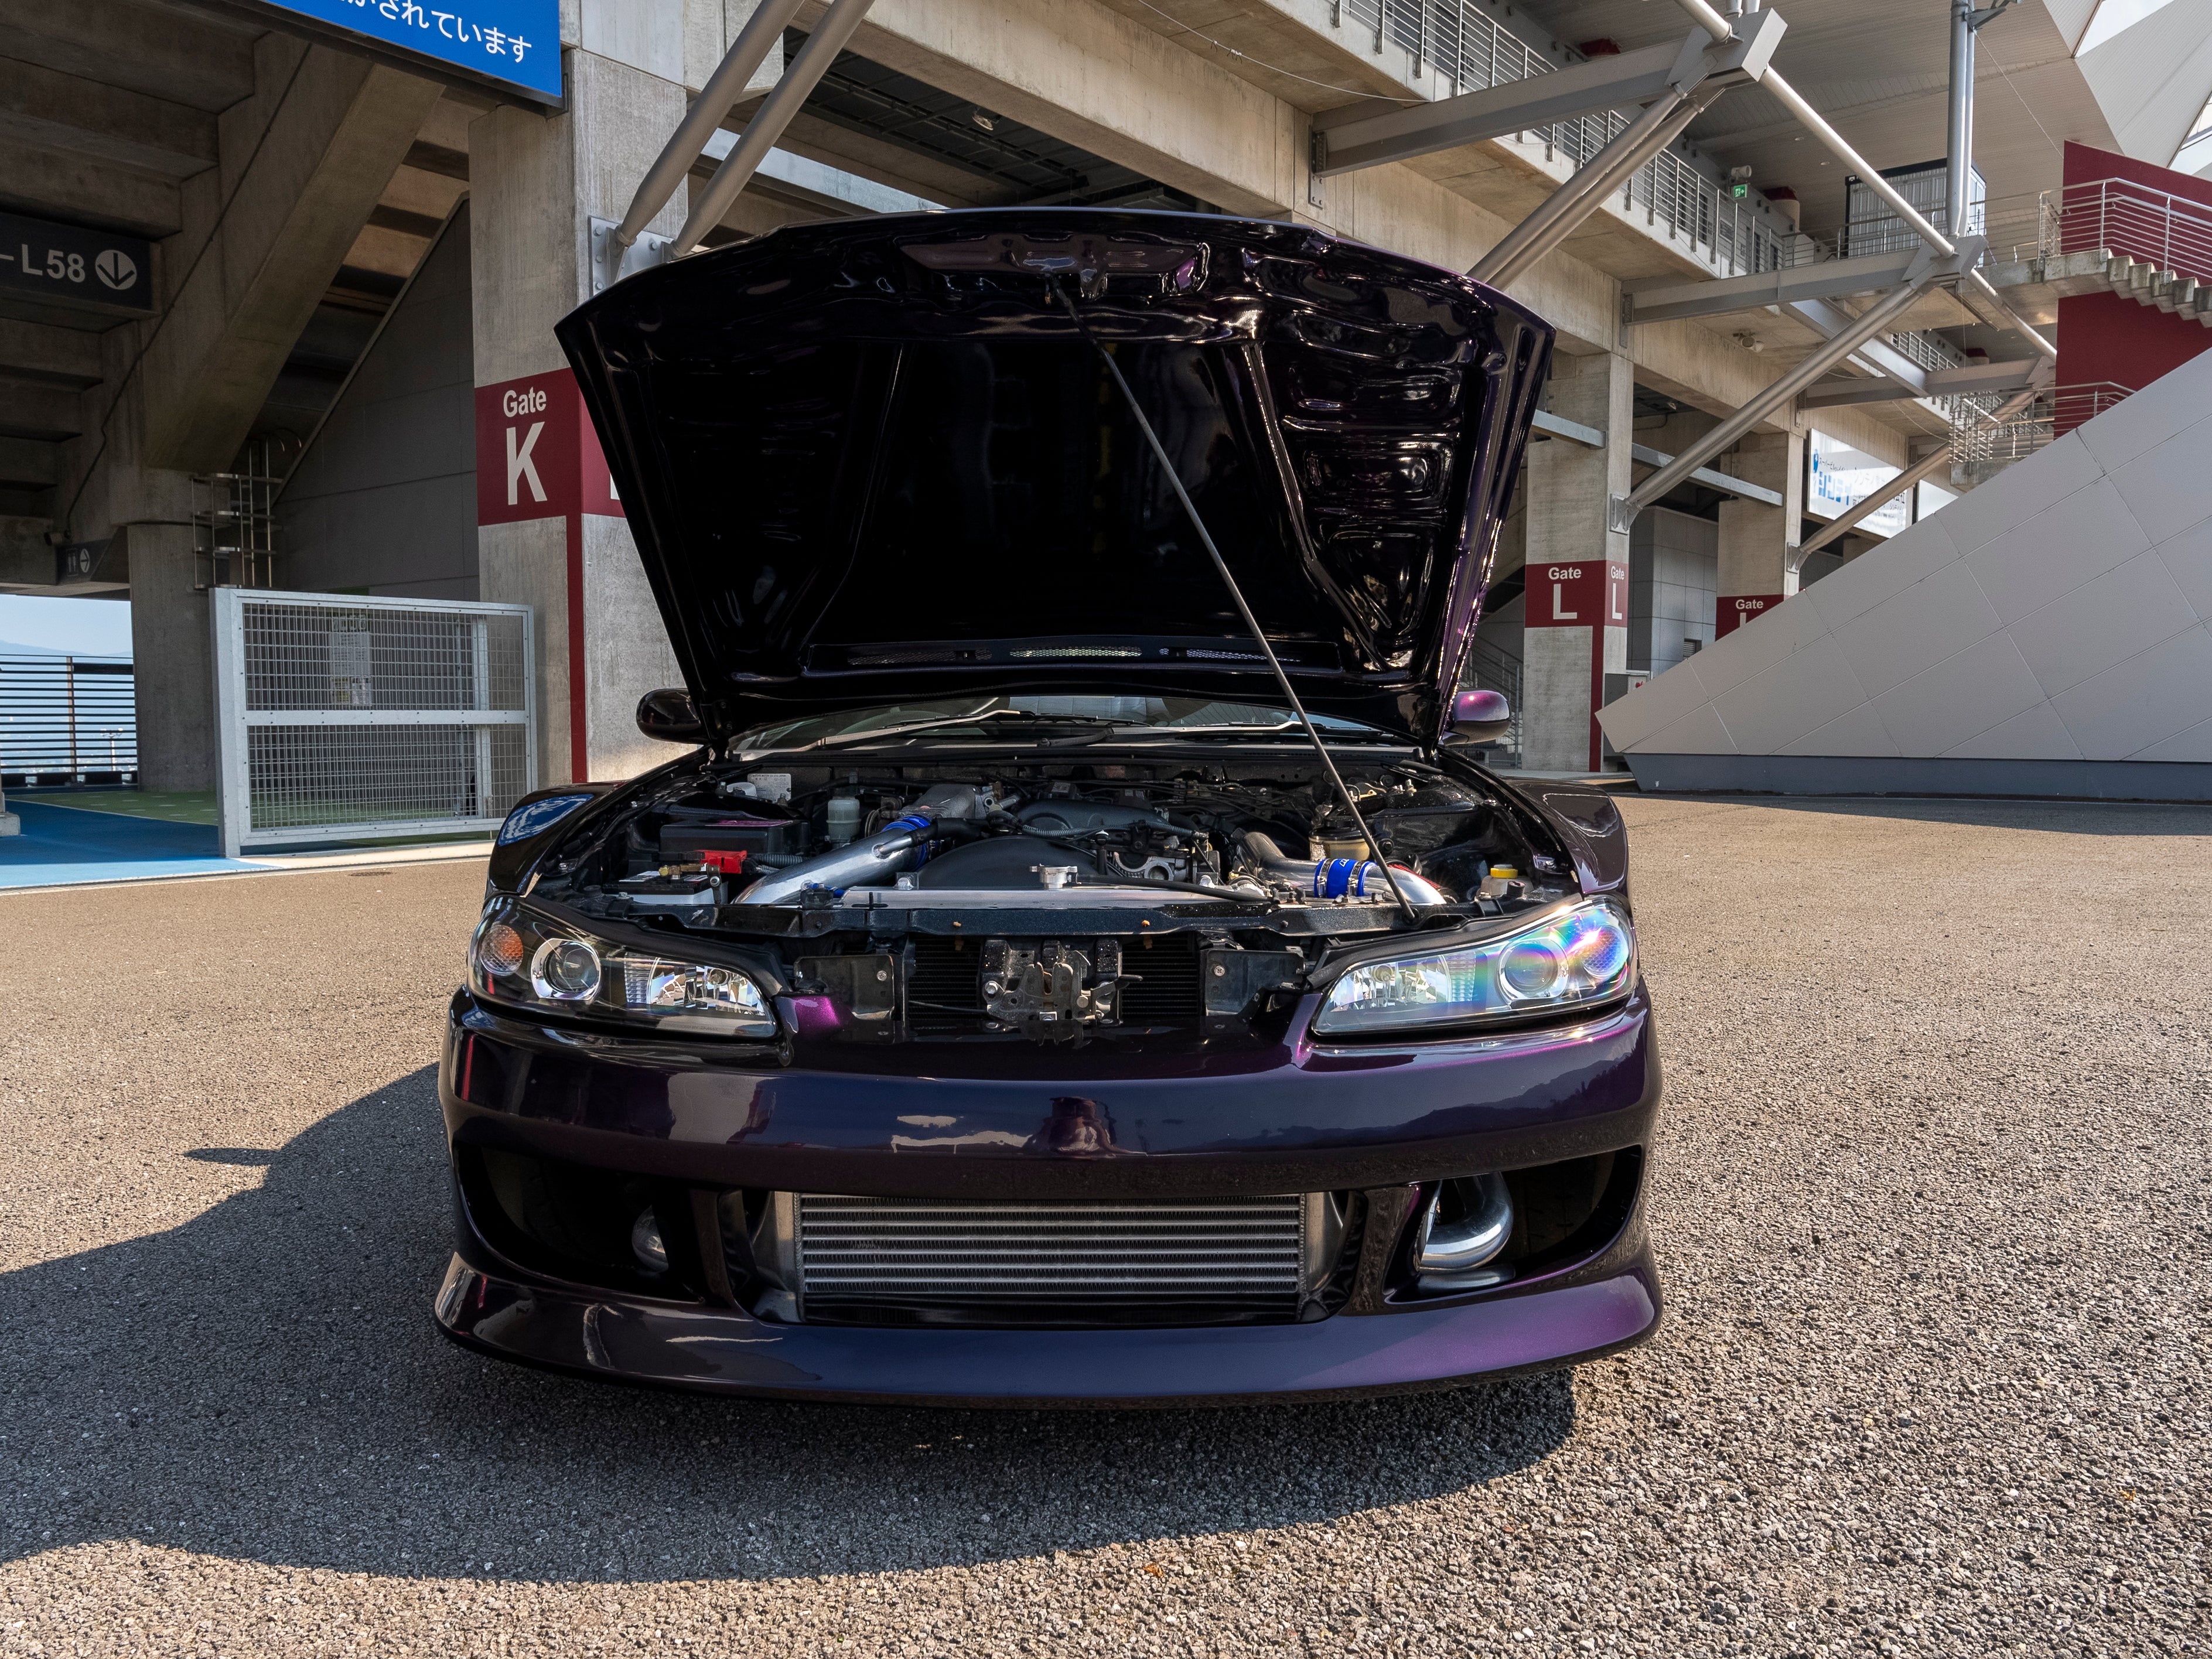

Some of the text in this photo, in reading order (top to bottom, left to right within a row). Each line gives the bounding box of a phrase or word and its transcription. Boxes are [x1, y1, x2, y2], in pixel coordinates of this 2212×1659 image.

[340, 0, 532, 63] されています
[503, 387, 547, 417] Gate
[506, 421, 547, 506] K
[1548, 566, 1582, 580] Gate
[1611, 566, 1624, 580] Gate
[1553, 583, 1578, 620] L
[1612, 583, 1622, 620] L
[1736, 599, 1764, 609] Gate
